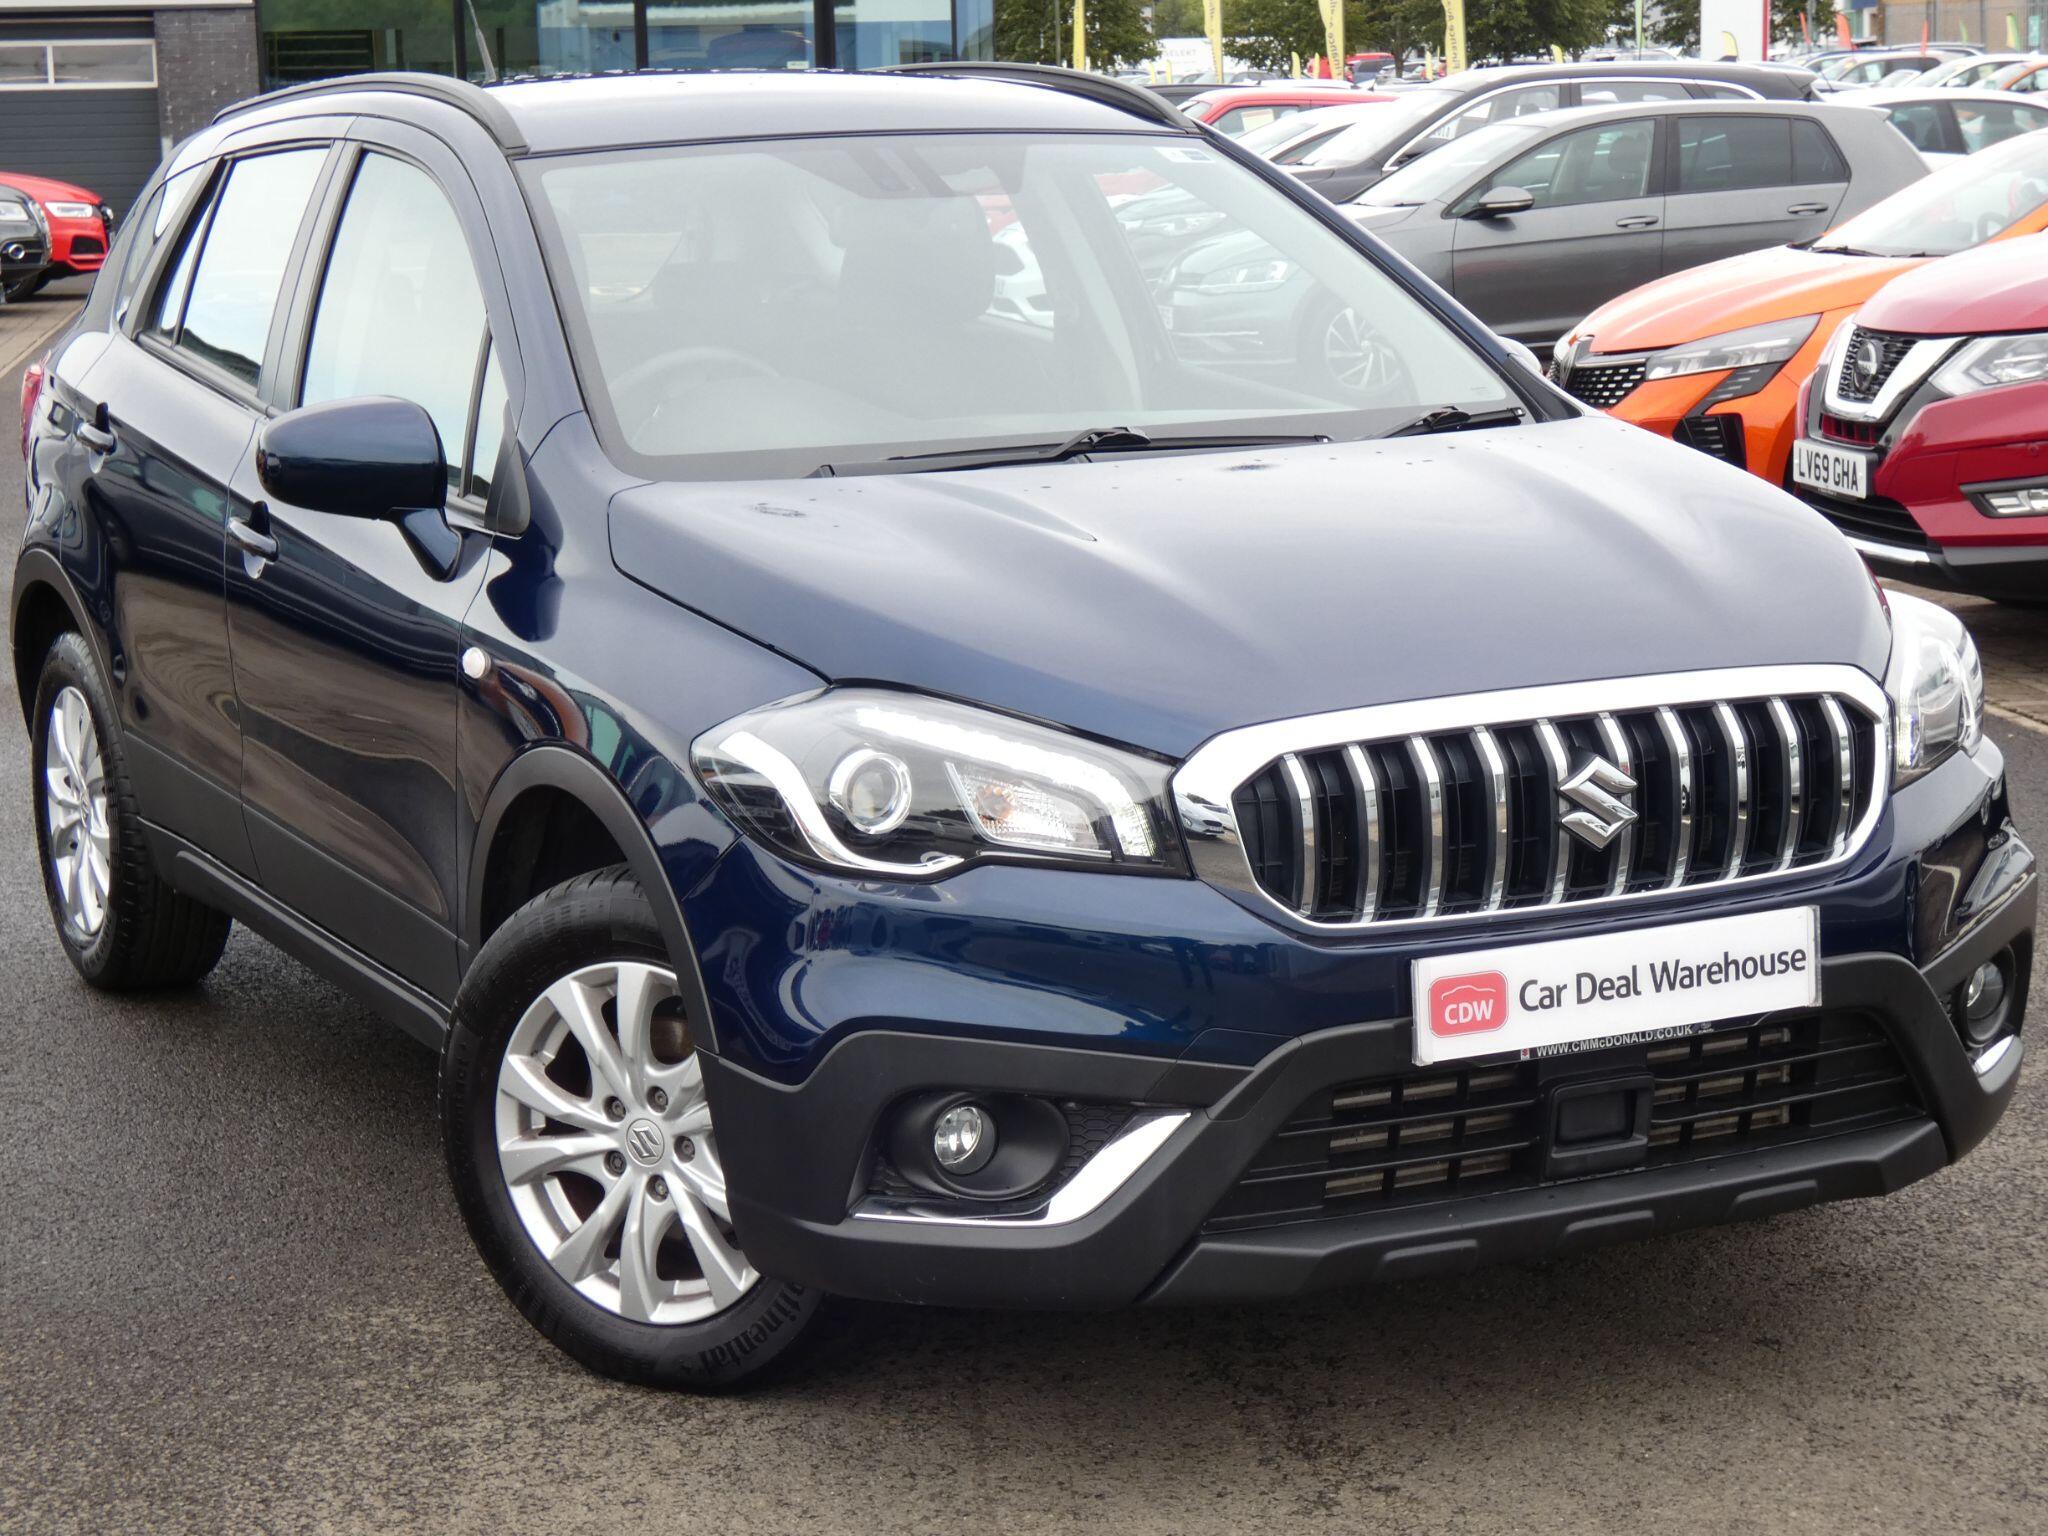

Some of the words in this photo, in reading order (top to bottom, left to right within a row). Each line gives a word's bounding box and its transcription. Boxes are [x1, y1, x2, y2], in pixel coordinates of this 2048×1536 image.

[1799, 448, 1830, 483] LV69
[1834, 457, 1858, 491] GHA
[1519, 979, 1568, 1012] Car
[1576, 964, 1642, 1005] Deal
[1649, 948, 1807, 993] Warehouse
[1444, 999, 1494, 1025] CDW
